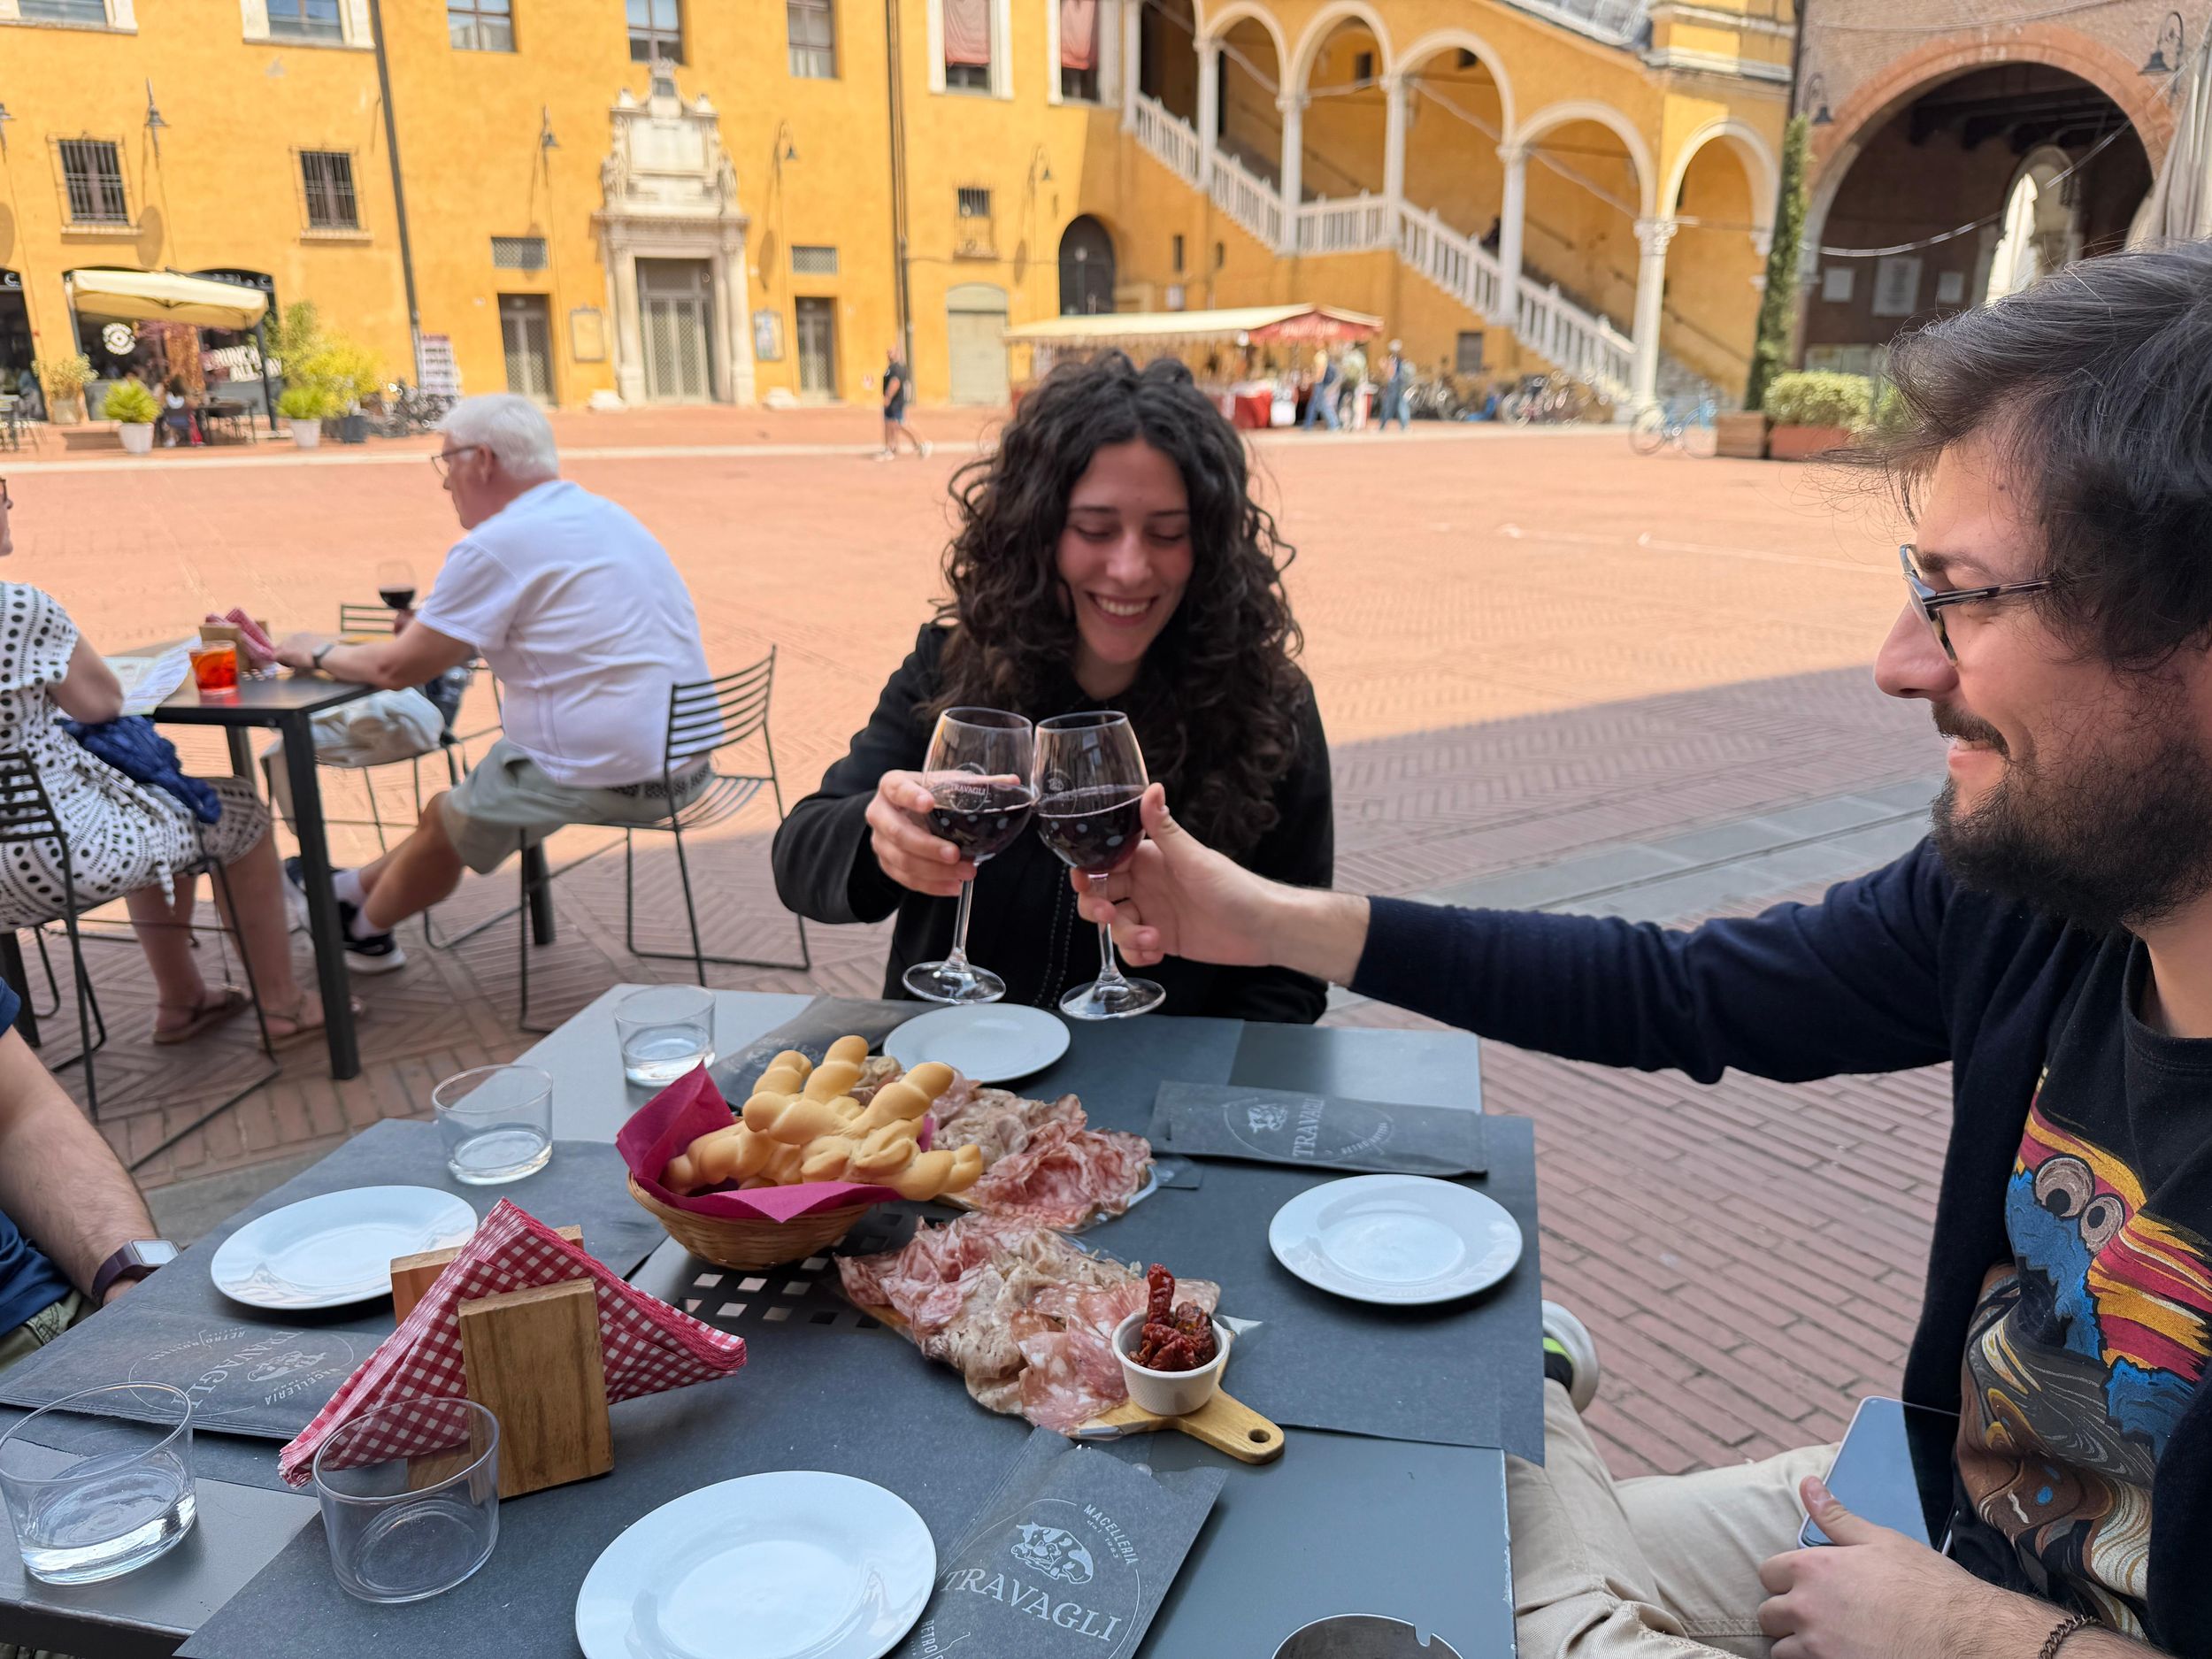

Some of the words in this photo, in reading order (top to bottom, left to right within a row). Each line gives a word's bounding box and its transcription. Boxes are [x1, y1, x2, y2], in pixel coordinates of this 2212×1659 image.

[170, 1331, 305, 1409] TRAVAGLI
[1083, 1503, 1140, 1565] MACELLERIA
[939, 1568, 1123, 1641] TRAVAGLI
